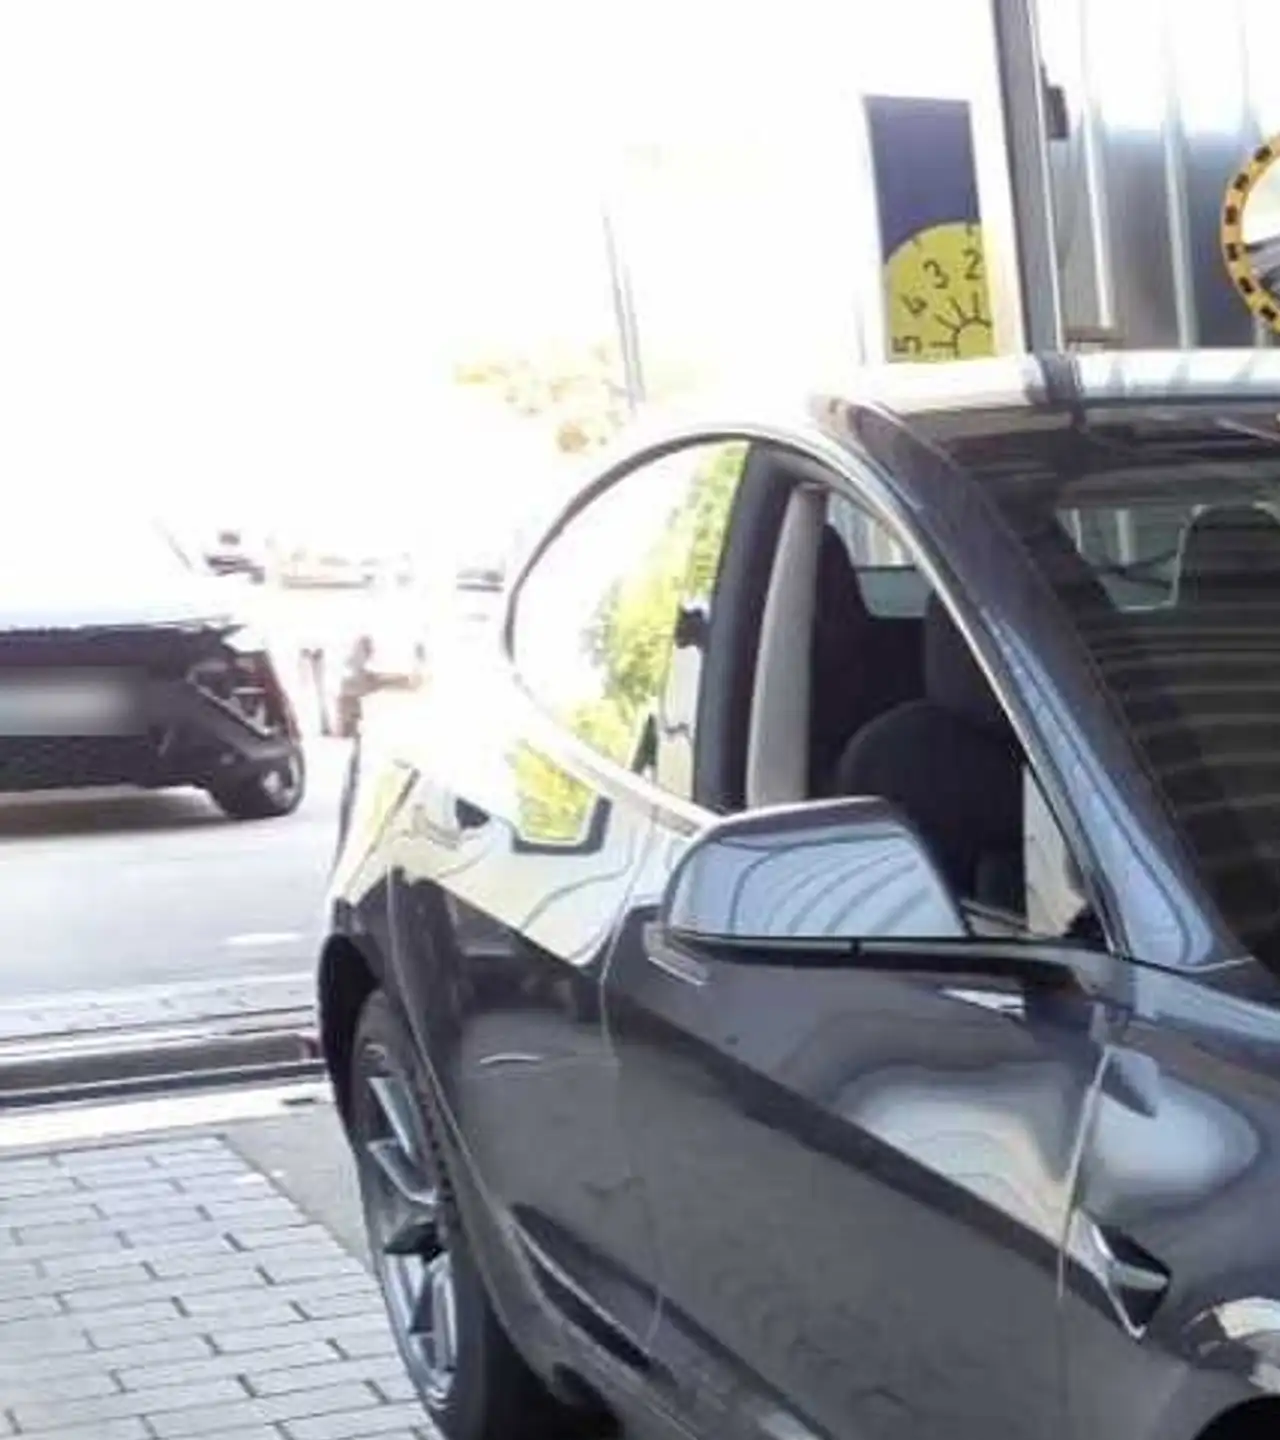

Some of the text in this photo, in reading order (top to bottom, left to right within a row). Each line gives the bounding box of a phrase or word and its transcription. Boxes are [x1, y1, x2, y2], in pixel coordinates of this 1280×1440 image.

[923, 260, 950, 290] 3
[962, 249, 983, 281] 2
[892, 334, 922, 354] 5
